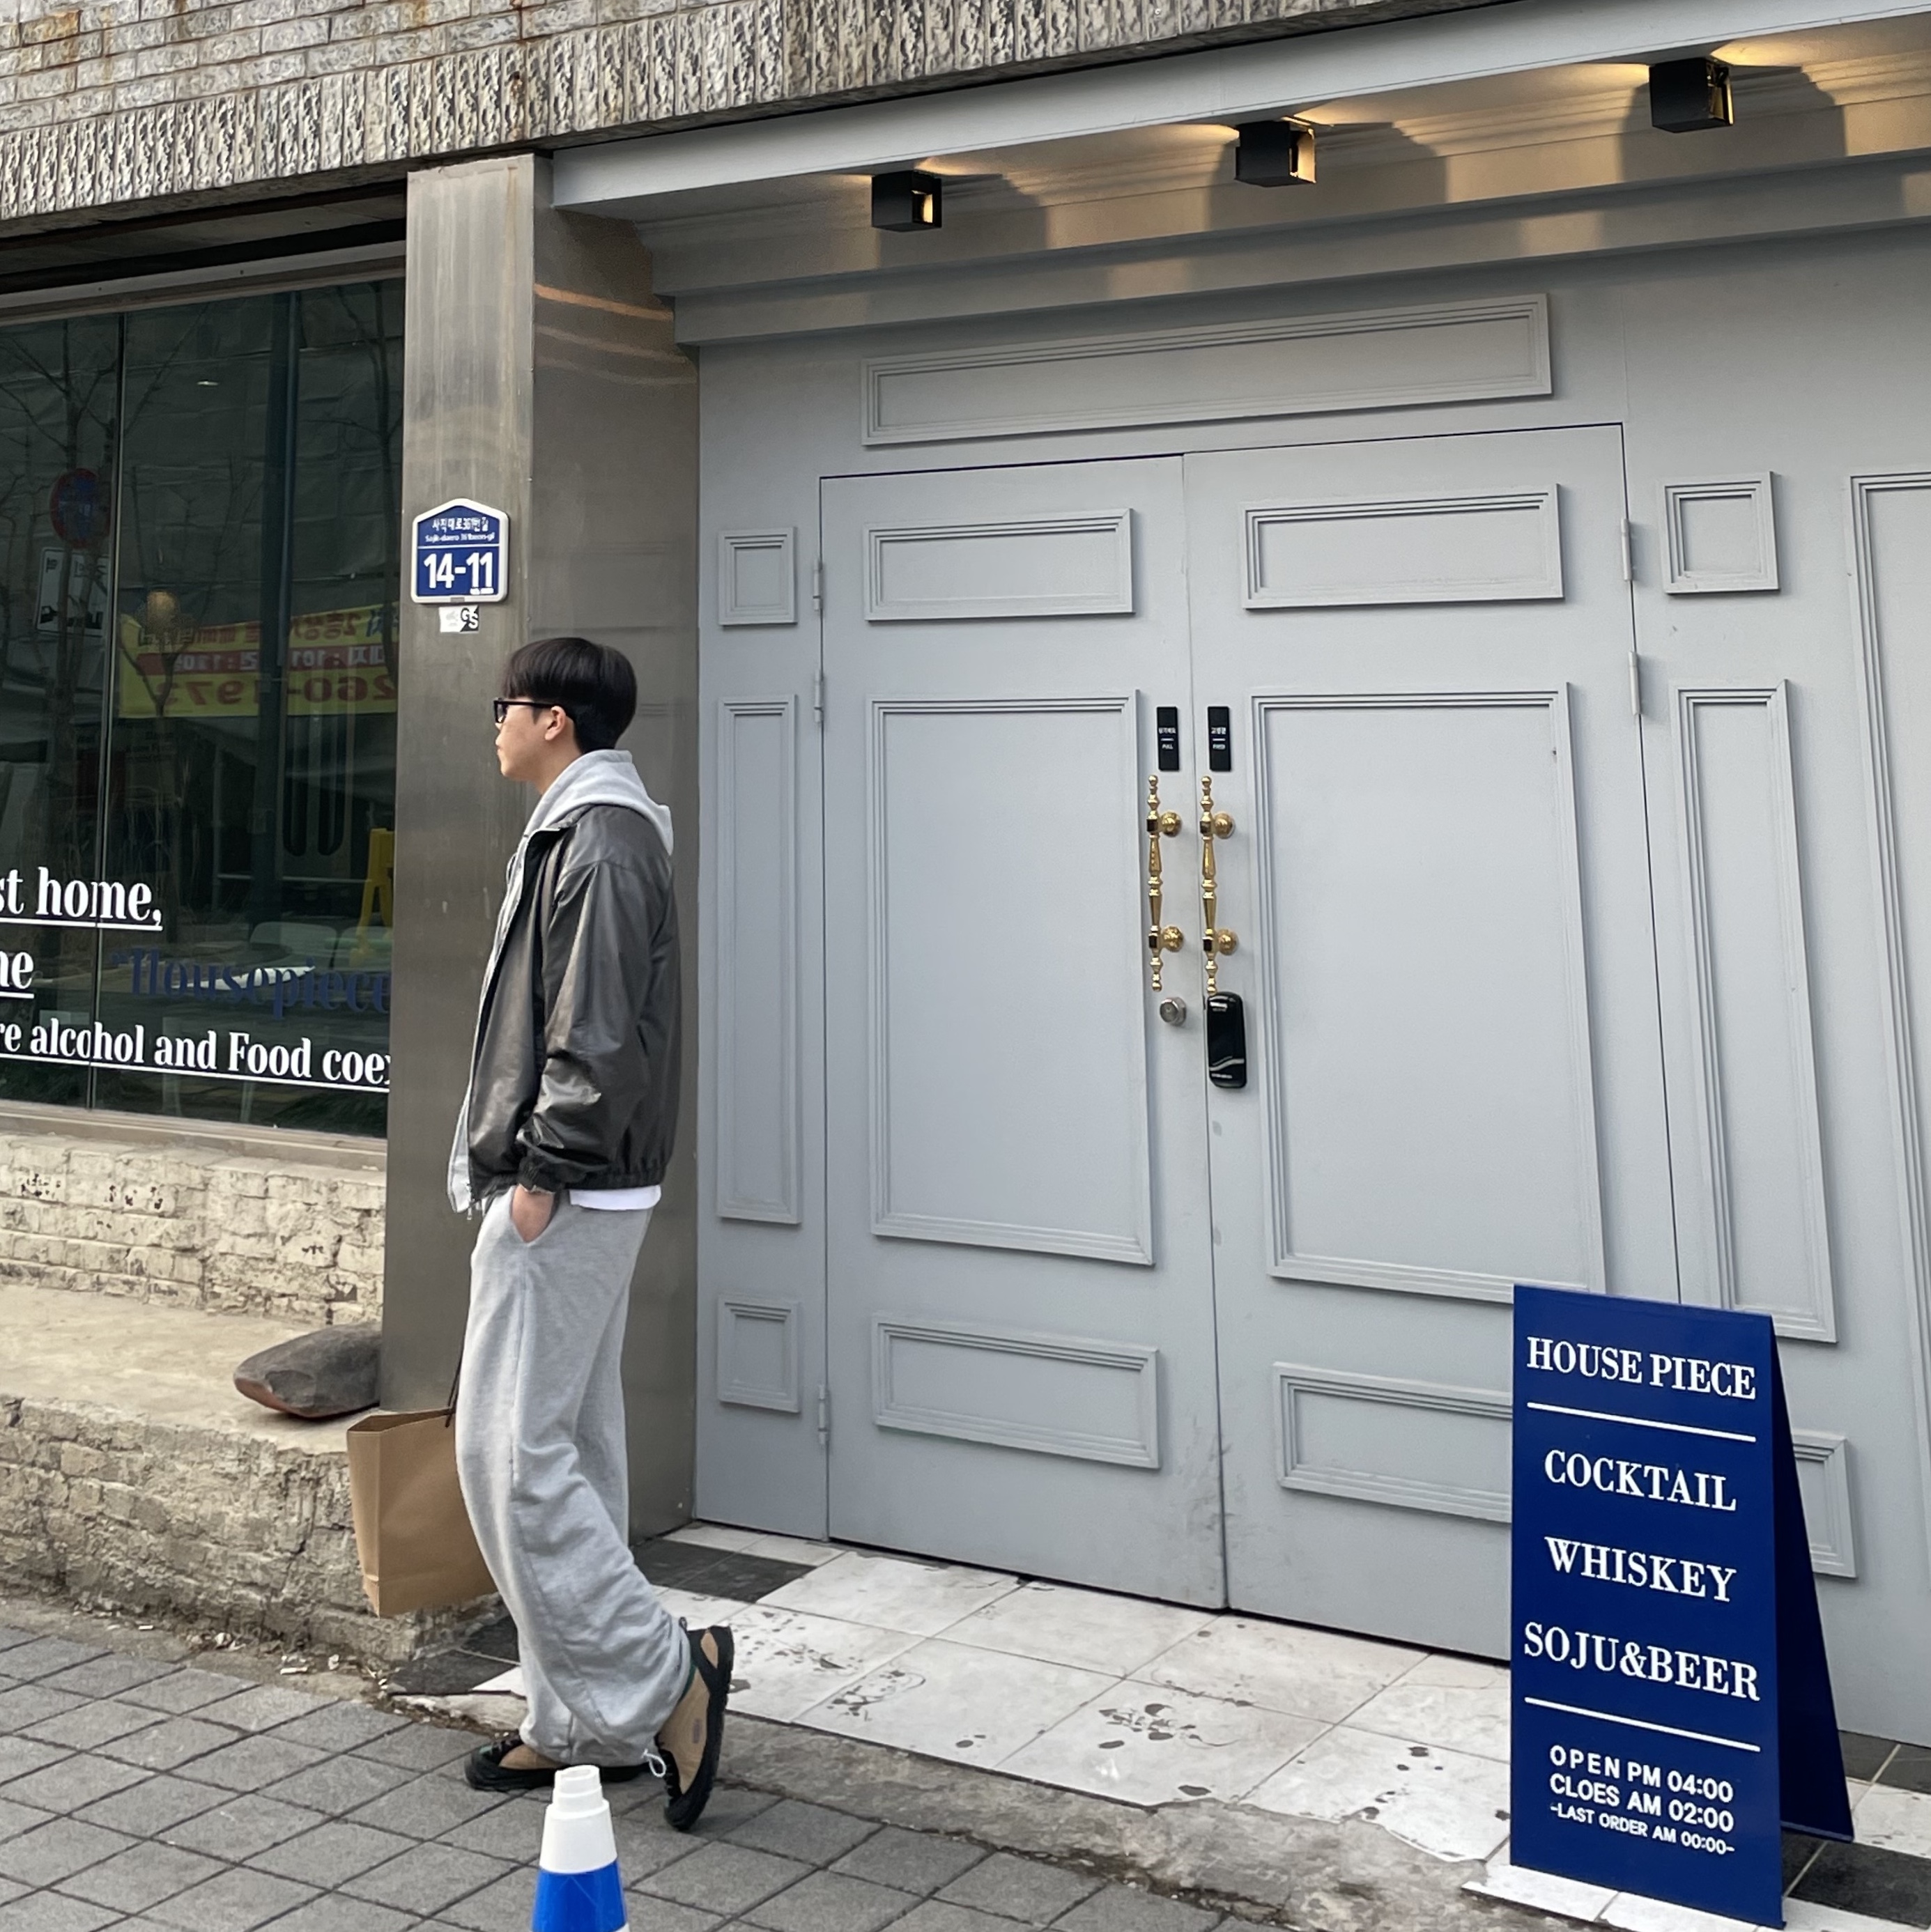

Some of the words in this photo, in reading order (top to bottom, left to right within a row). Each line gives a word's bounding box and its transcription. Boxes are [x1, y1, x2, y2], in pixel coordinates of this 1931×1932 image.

[424, 552, 493, 589] 14-11
[36, 866, 162, 927] home,
[30, 1017, 144, 1063] alcohol
[154, 1030, 217, 1069] and
[228, 1031, 311, 1078] Food
[1527, 1336, 1642, 1384] HOUSE
[1649, 1354, 1755, 1400] PIECE
[1544, 1449, 1737, 1511] COCKTAIL
[1544, 1536, 1737, 1602] WHISKEY
[1524, 1621, 1760, 1701] SOJU&BEER
[1550, 1745, 1620, 1779] OPEN
[1627, 1761, 1661, 1788] PM
[1667, 1770, 1733, 1803] 04:00
[1550, 1773, 1620, 1807] CLOES
[1626, 1791, 1661, 1816] AM
[1668, 1799, 1734, 1832] 02:00
[1599, 1813, 1648, 1837] ORDER
[1652, 1825, 1677, 1843] AM
